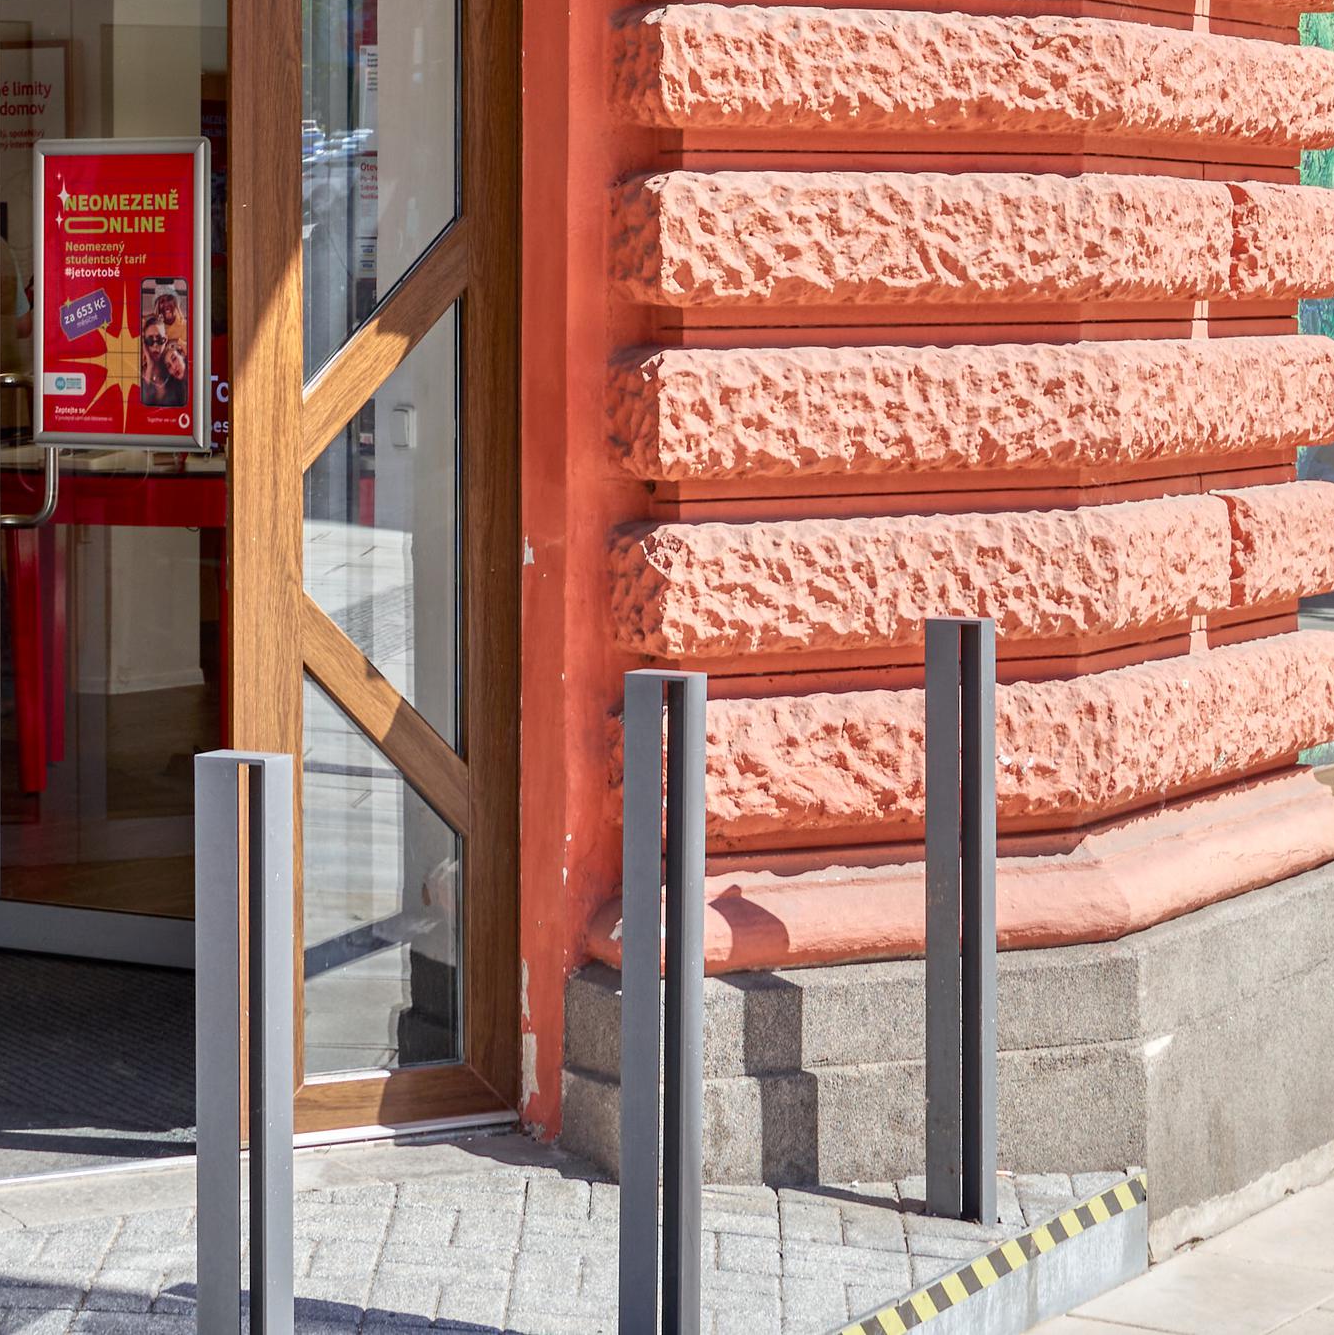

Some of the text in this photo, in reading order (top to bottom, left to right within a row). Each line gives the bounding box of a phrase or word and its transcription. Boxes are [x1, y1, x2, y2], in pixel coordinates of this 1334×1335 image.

[13, 81, 52, 98] limity
[0, 102, 45, 116] domov
[64, 188, 179, 211] NEOMEZENĚ
[65, 241, 125, 253] Neomezený
[65, 254, 147, 266] studentský tarif
[64, 267, 121, 280] #jetovtobě
[64, 297, 107, 325] za 653 Kč
